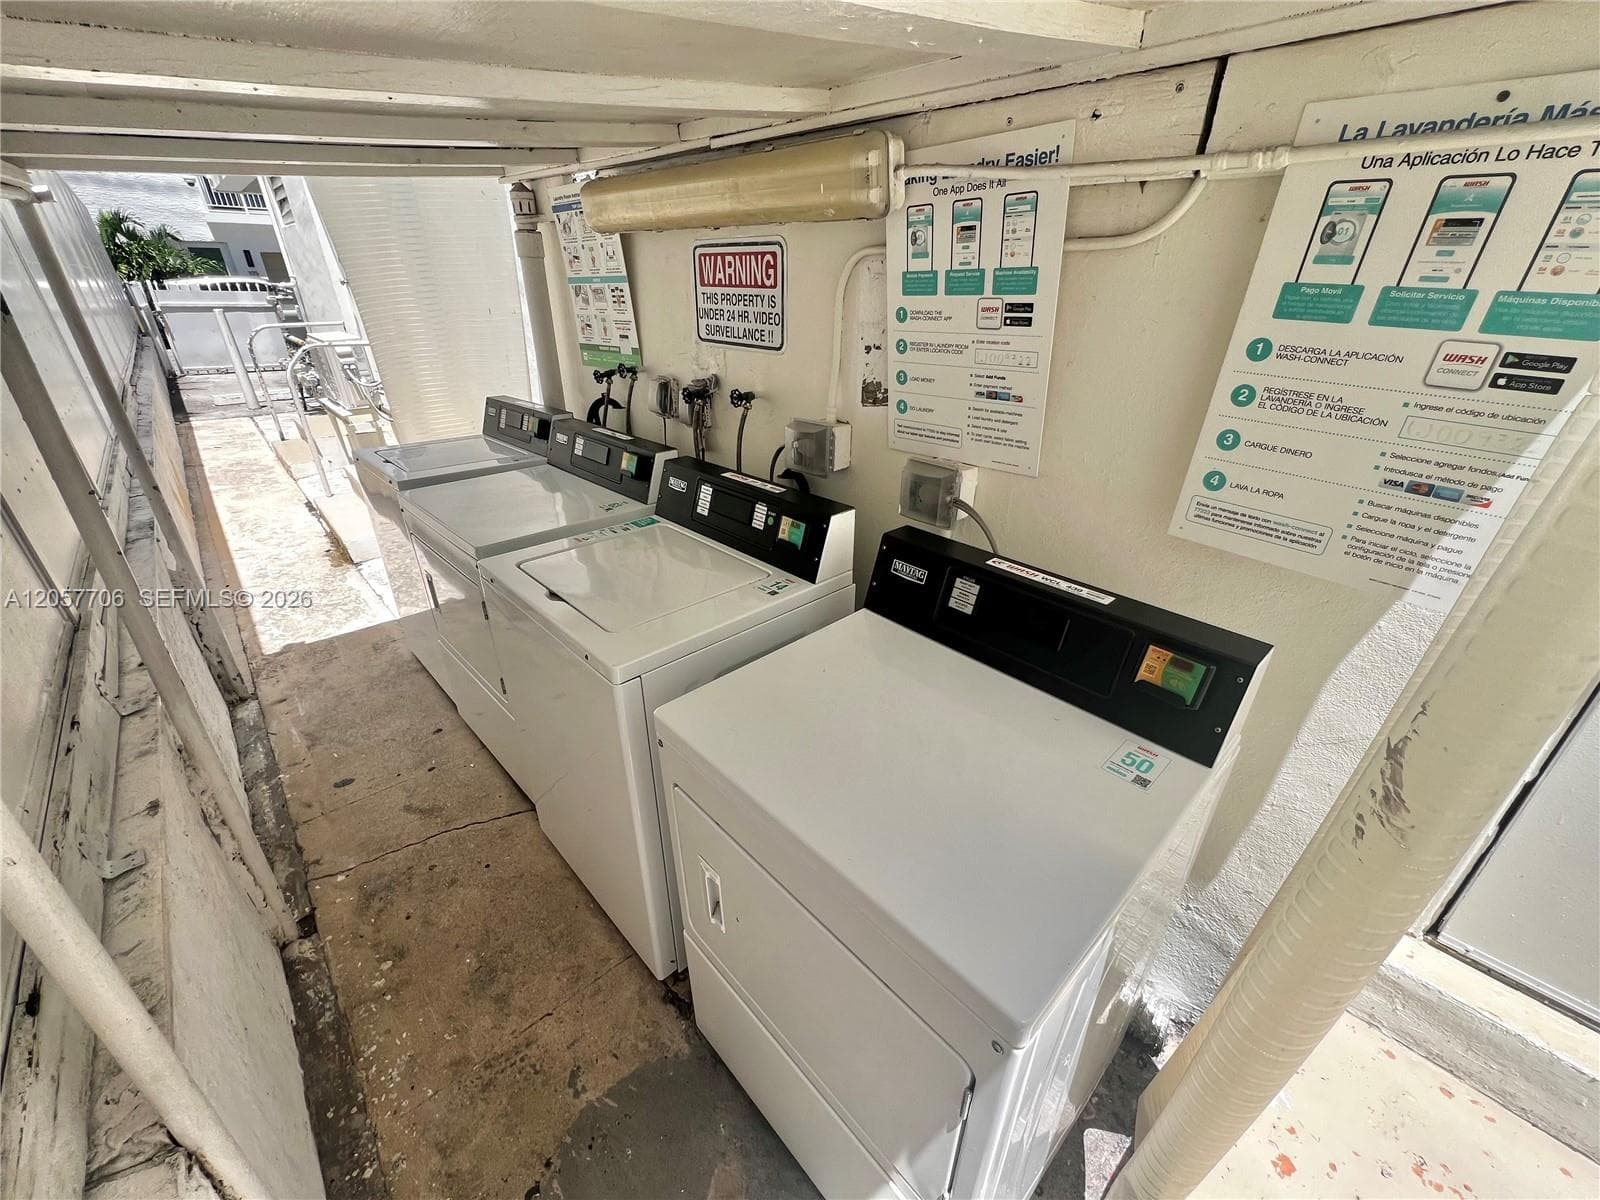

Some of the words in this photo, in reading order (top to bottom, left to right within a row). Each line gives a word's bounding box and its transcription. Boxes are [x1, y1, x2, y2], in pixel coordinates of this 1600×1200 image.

[1338, 124, 1369, 143] La
[1376, 107, 1530, 139] Lavandería
[1005, 144, 1060, 167] Easier!
[1361, 155, 1394, 170] Una
[1397, 148, 1490, 170] Aplicación
[1495, 146, 1520, 162] Lo
[1526, 143, 1582, 160] Hace
[933, 187, 948, 197] One
[950, 185, 965, 195] App
[967, 182, 987, 193] Does
[989, 180, 995, 189] It
[996, 178, 1007, 188] All
[701, 254, 774, 286] WARNING
[1300, 286, 1320, 295] Pago
[1389, 290, 1426, 299] Solicitar
[1427, 292, 1466, 301] Servicio
[701, 292, 719, 305] THIS
[721, 293, 765, 308] PROPERTY
[768, 295, 777, 309] IS
[1497, 295, 1548, 305] Máquinas
[699, 307, 725, 322] UNDER
[727, 309, 735, 322] 24
[737, 310, 752, 323] HR.
[753, 311, 780, 326] VIDEO
[705, 323, 766, 342] SURVEILLANCE
[768, 330, 774, 343] !!
[1256, 342, 1264, 355] 1
[1278, 344, 1327, 357] DESCARGA
[1328, 346, 1341, 358] LA
[1343, 350, 1405, 364] APLICACIÓN
[1275, 352, 1350, 367] WASH-CONNECT
[1442, 353, 1489, 366] WASH
[1521, 360, 1551, 369] Google
[1551, 361, 1569, 371] Play
[910, 375, 919, 383] LOAD
[1436, 367, 1480, 378] CONNECT
[1509, 380, 1527, 389] App
[1527, 382, 1552, 391] Store
[1238, 389, 1249, 401] 2
[1262, 386, 1315, 401] REGÍSTRESE
[1316, 393, 1330, 402] EN
[1331, 395, 1343, 404] LA
[1257, 401, 1268, 410] EL
[1269, 402, 1305, 415] CÓDIGO
[1305, 408, 1319, 417] DE
[1320, 410, 1333, 419] LA
[1334, 413, 1389, 428] UBICACIÓN
[1314, 401, 1323, 409] O
[1324, 402, 1366, 416] INGRESE
[1413, 402, 1444, 413] Ingrese
[1455, 406, 1486, 419] código
[1487, 411, 1500, 420] de
[1501, 412, 1547, 426] ubicación
[1223, 433, 1234, 446] 3
[1244, 440, 1278, 453] CARGUE
[1279, 446, 1313, 460] DINERO
[1389, 452, 1433, 465] Seleccione
[1433, 461, 1466, 471] agregar
[1209, 475, 1220, 486] 4
[1383, 465, 1423, 479] Introdusca
[1434, 475, 1465, 487] método
[1466, 481, 1479, 489] de
[1480, 484, 1504, 493] pago
[1383, 478, 1405, 488] VISA
[1229, 482, 1249, 492] LAVA
[1250, 487, 1261, 495] LA
[1262, 489, 1285, 500] ROPA
[1367, 499, 1394, 511] Buscar
[1394, 506, 1432, 519] máquinas
[1433, 515, 1480, 530] disponibles
[1361, 512, 1389, 523] Cargue
[1389, 518, 1397, 526] la
[1398, 521, 1416, 530] ropa
[1432, 528, 1477, 543] detergente
[1355, 524, 1395, 539] Seleccione
[1396, 532, 1429, 545] máquina
[1437, 545, 1463, 555] pague
[1347, 544, 1395, 559] configuración
[1395, 555, 1407, 563] de
[1416, 560, 1430, 569] tela
[1351, 535, 1367, 545] Para
[1368, 541, 1390, 550] iniciar
[1420, 553, 1463, 568] seleccione
[1463, 563, 1472, 571] la
[894, 561, 925, 579] MAYTAG
[1351, 552, 1372, 562] botón
[1384, 561, 1404, 570] inicio
[1416, 567, 1424, 575] la
[1424, 571, 1459, 584] máquina
[1041, 576, 1062, 586] WCL
[1120, 751, 1155, 775] 50
